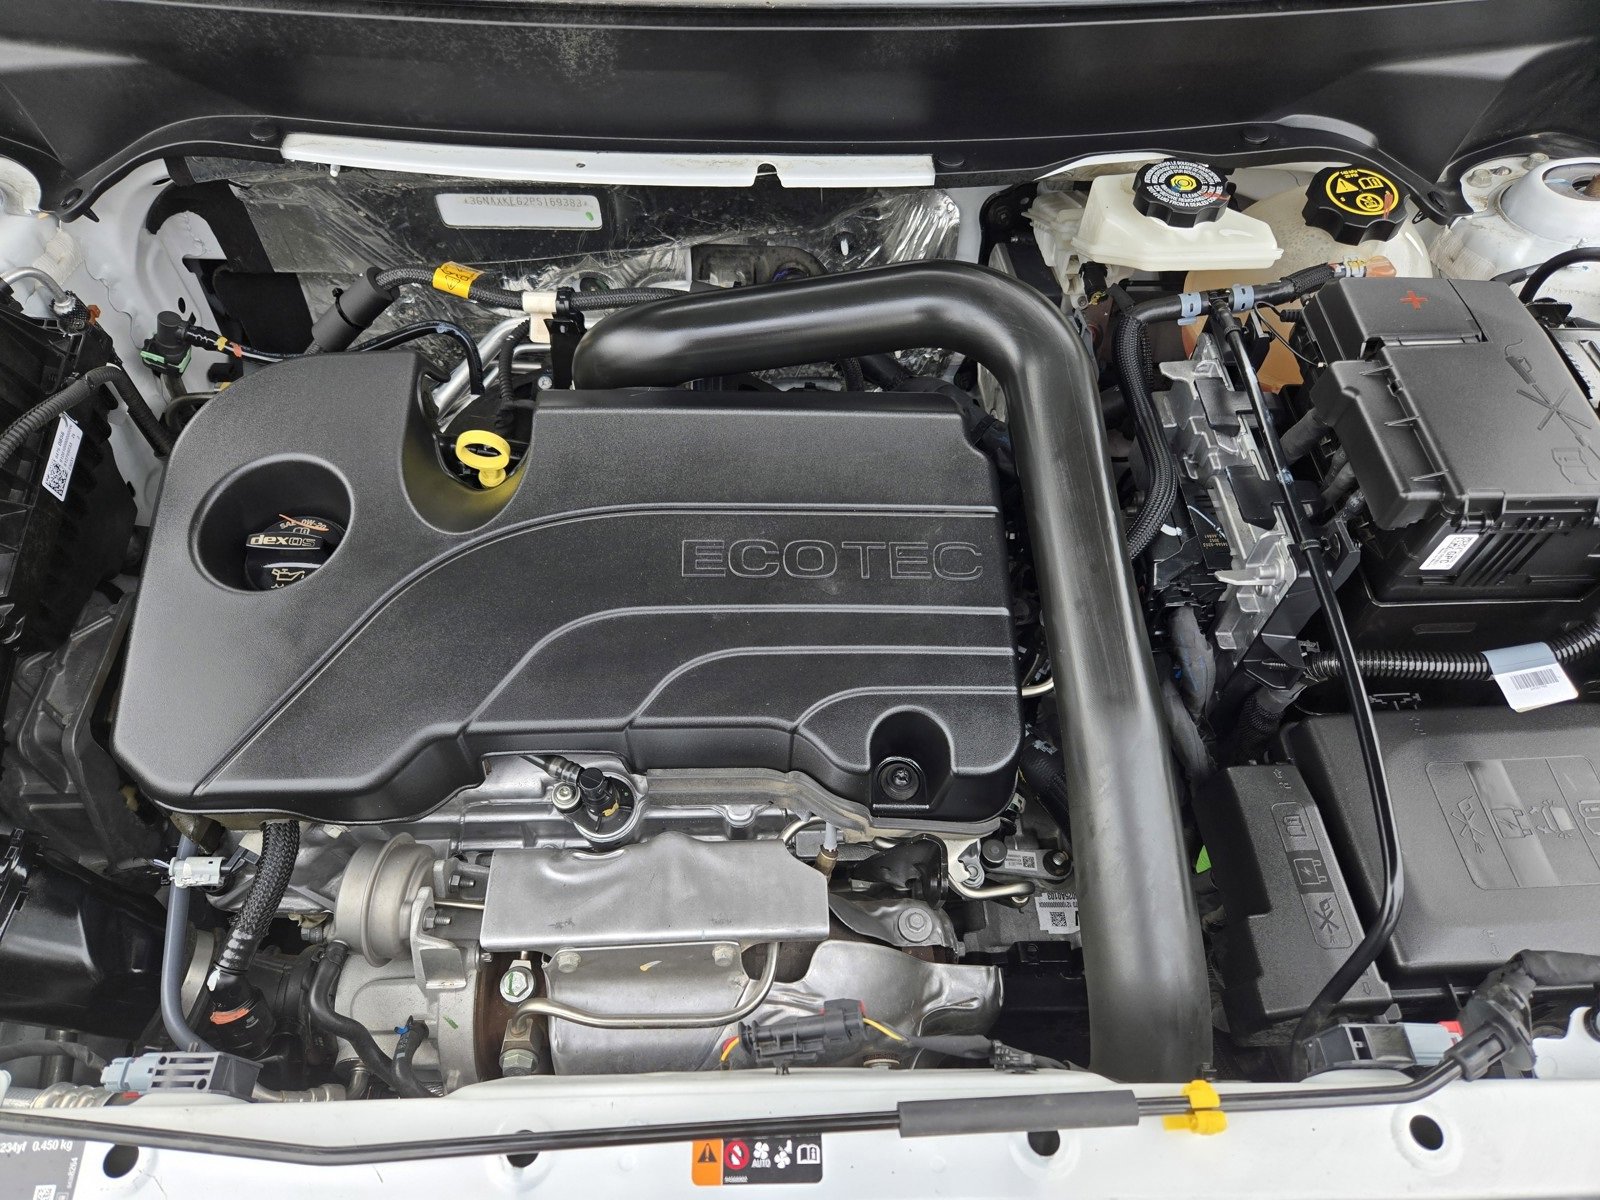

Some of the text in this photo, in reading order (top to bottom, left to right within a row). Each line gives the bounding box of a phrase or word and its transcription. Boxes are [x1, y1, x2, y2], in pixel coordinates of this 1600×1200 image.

[250, 534, 316, 547] dexos
[681, 539, 983, 581] ECOTEC
[32, 1139, 59, 1152] 0.450
[60, 1139, 73, 1152] kg
[751, 1158, 771, 1168] AUTO
